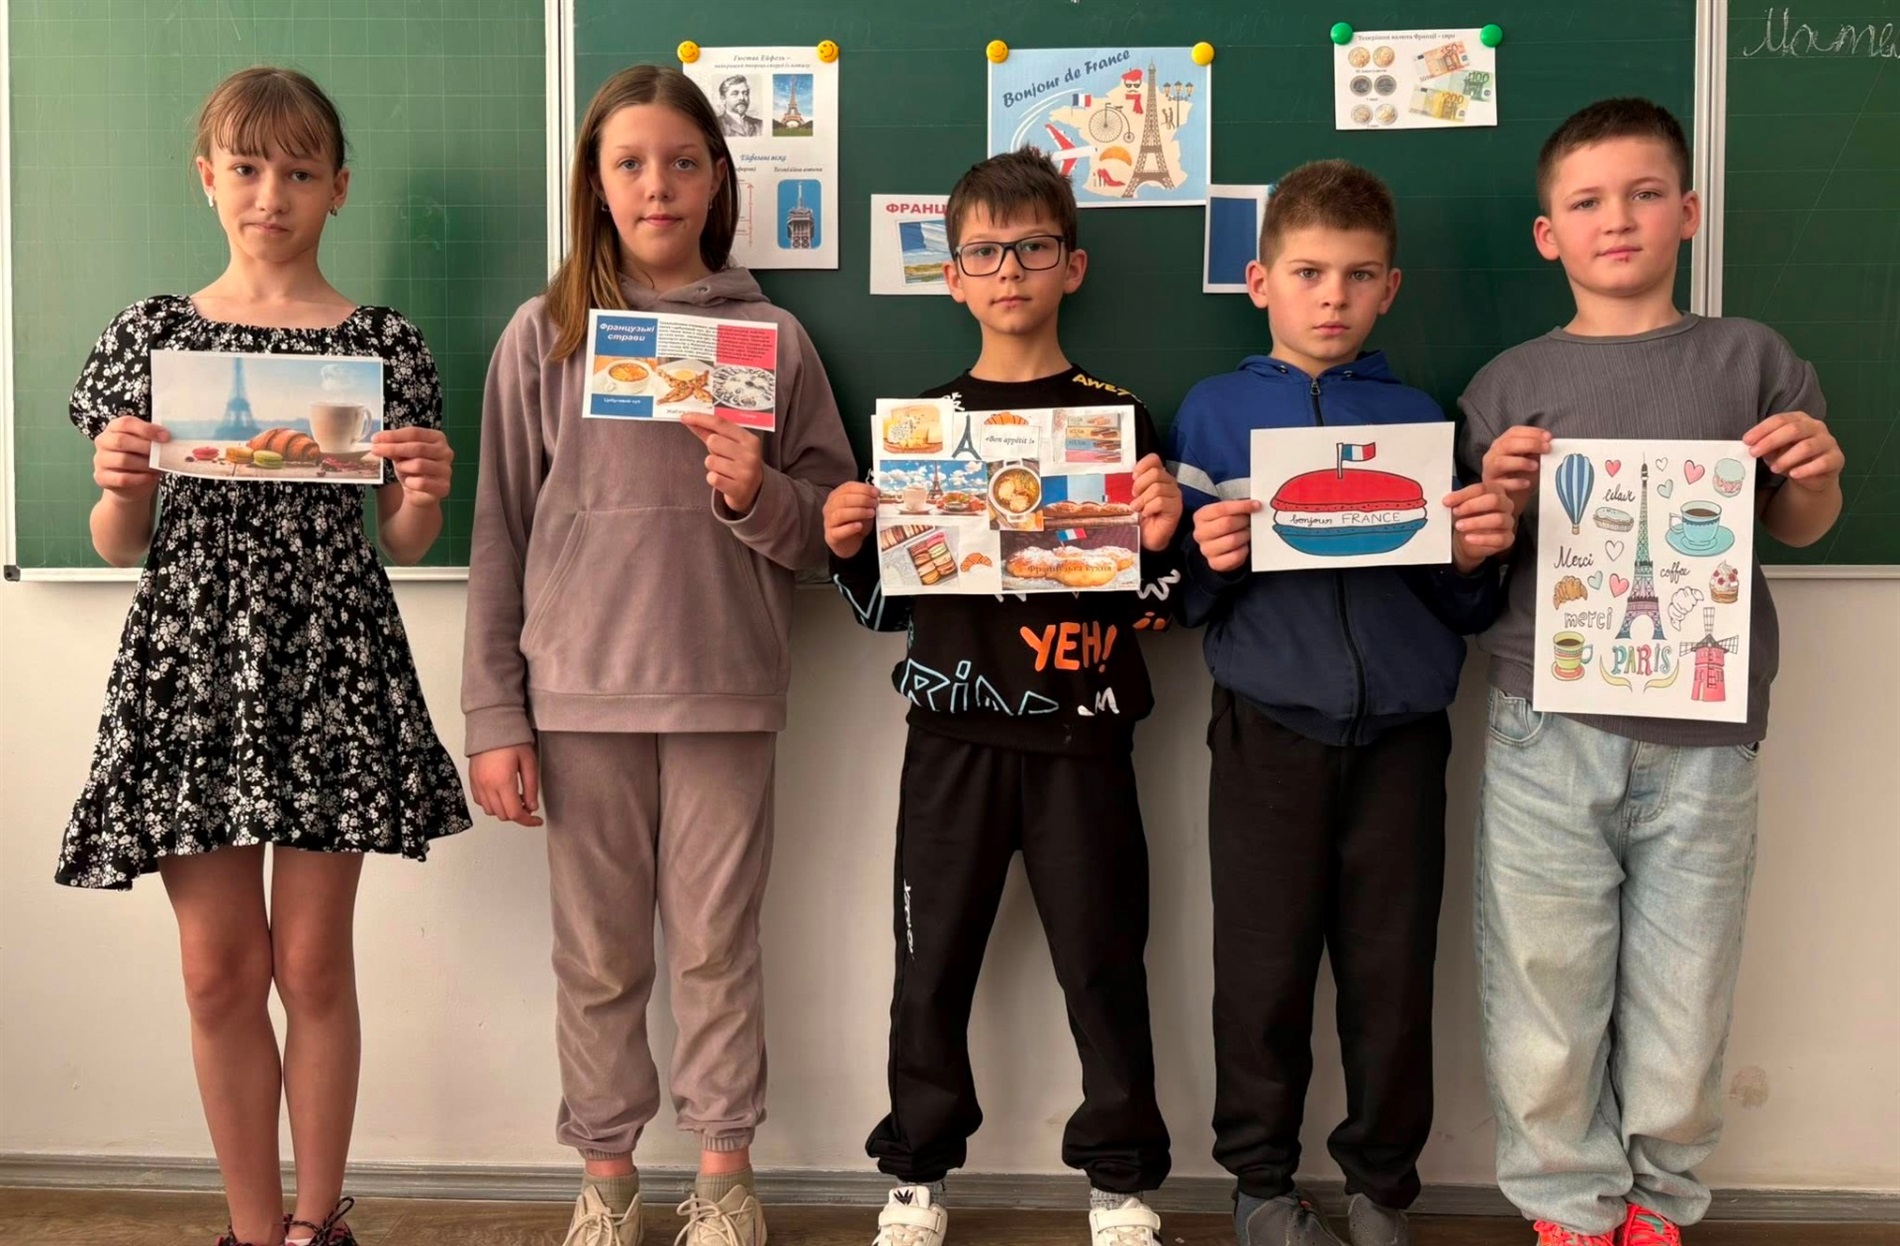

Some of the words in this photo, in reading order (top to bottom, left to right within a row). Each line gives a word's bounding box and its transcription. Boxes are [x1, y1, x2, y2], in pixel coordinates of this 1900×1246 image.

[1002, 77, 1060, 108] Bonjour
[1064, 67, 1081, 83] de
[1084, 50, 1130, 74] France
[885, 203, 948, 215] ФРАНЦ
[600, 323, 656, 334] Французькі
[607, 333, 646, 342] страви
[1341, 512, 1401, 525] FRANCE
[1554, 545, 1594, 568] Merci
[1659, 561, 1691, 584] coffee
[1564, 607, 1614, 631] merci
[1019, 620, 1118, 673] YEH!
[1611, 643, 1673, 676] PARIS
